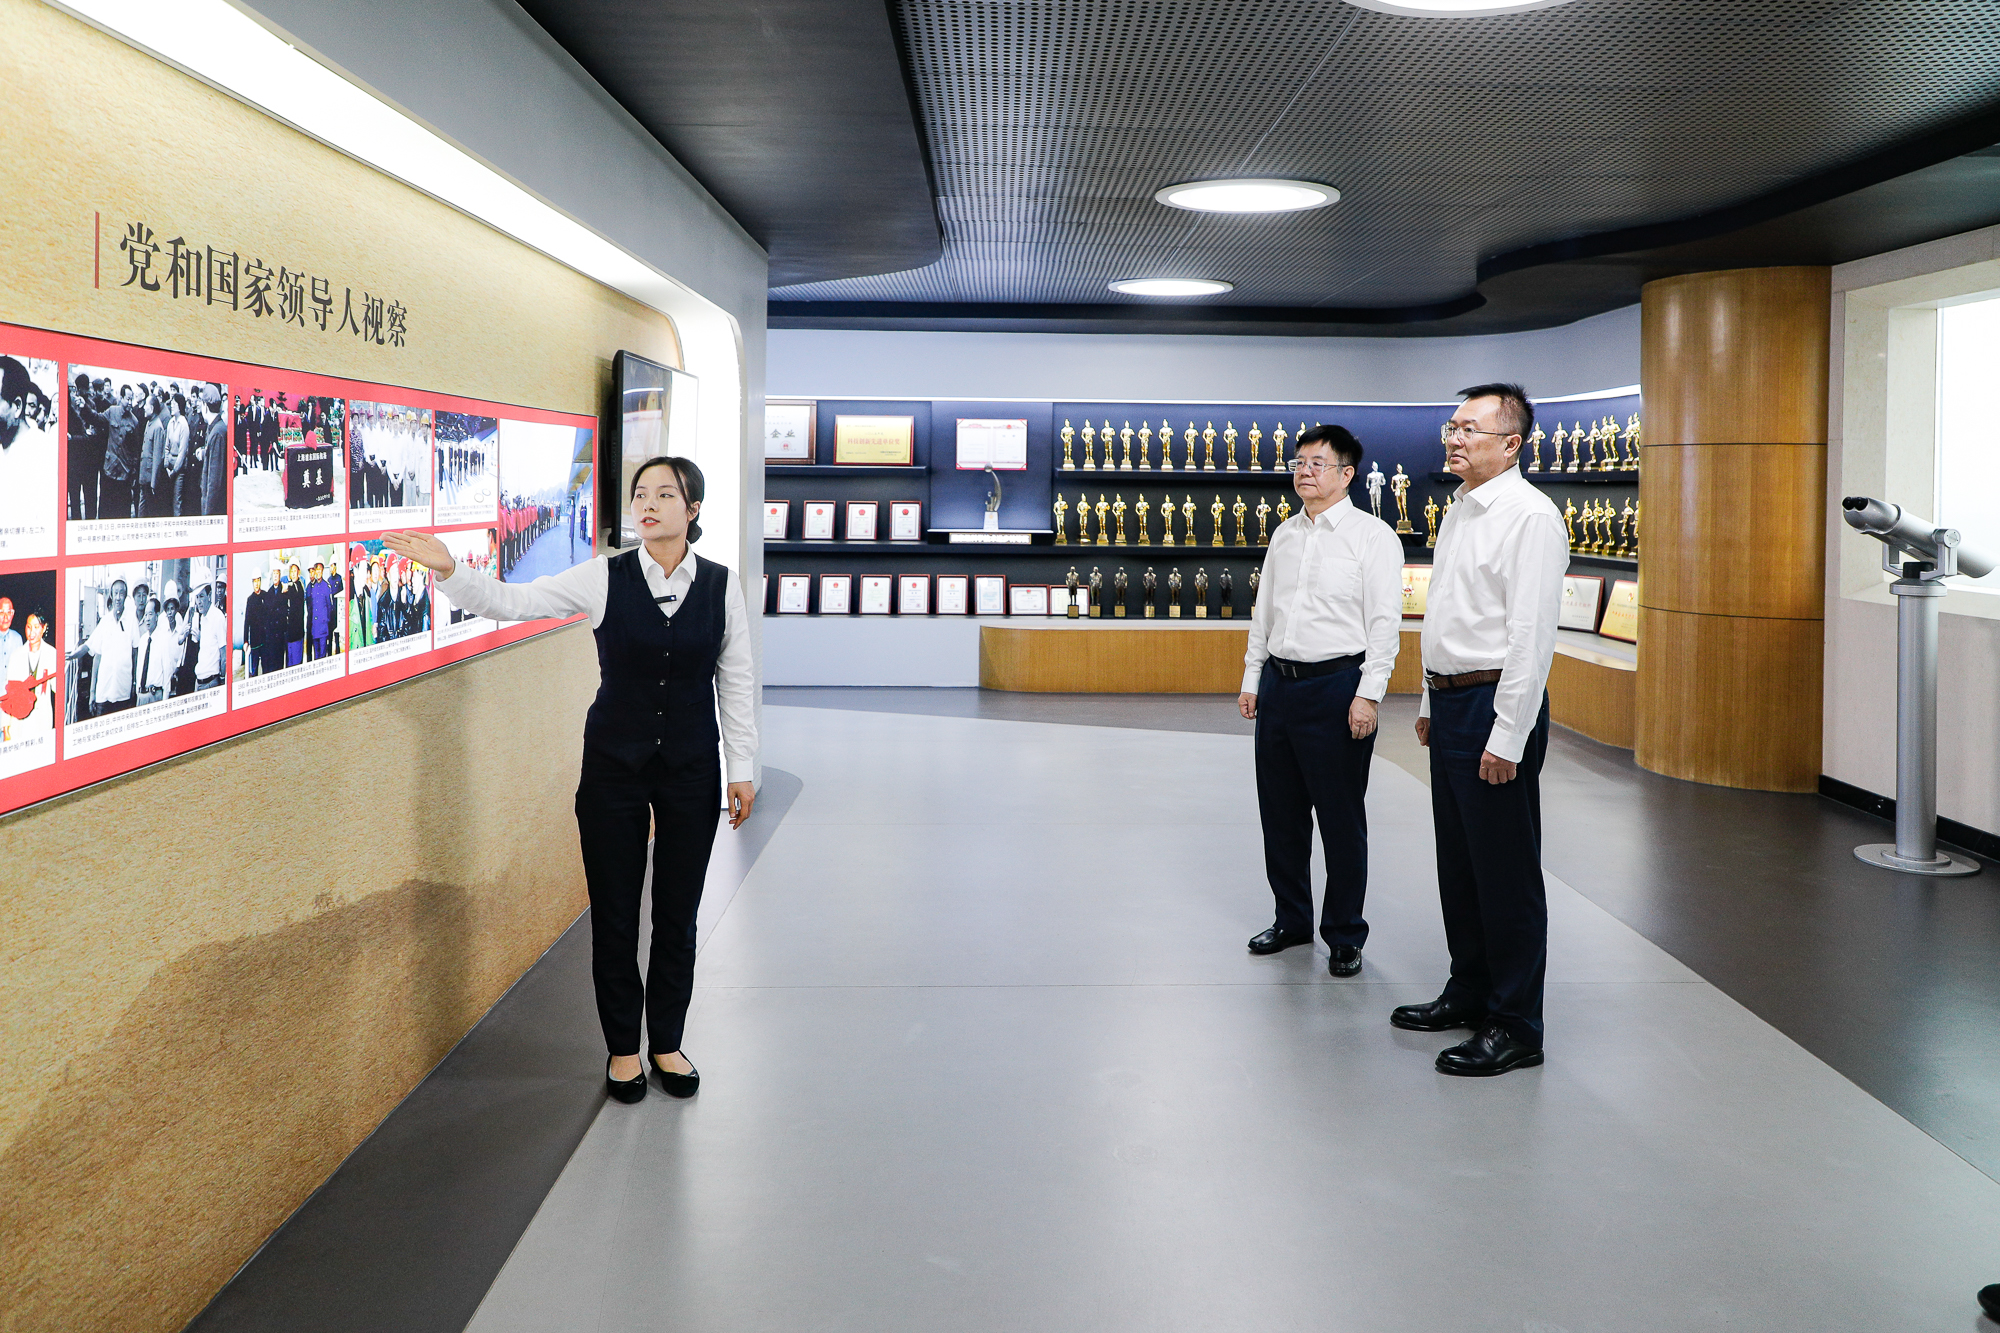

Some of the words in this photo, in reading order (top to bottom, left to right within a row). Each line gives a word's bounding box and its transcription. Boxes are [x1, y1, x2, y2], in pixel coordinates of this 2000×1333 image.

[119, 221, 409, 348] 党和国家领导人视察
[302, 467, 324, 489] 奠基
